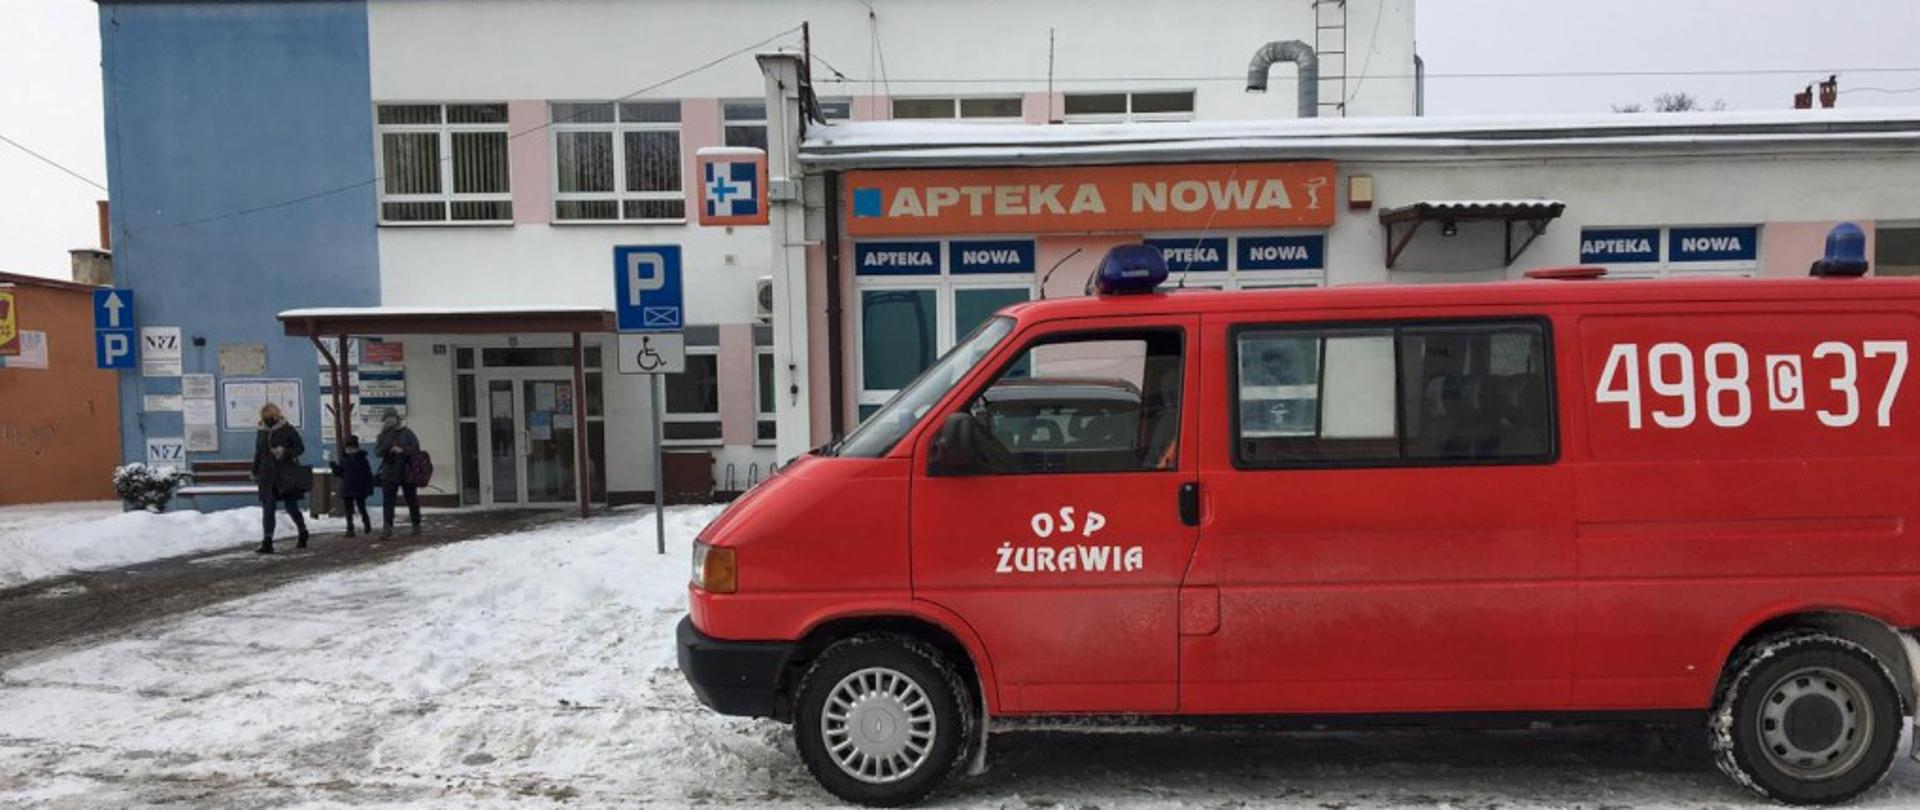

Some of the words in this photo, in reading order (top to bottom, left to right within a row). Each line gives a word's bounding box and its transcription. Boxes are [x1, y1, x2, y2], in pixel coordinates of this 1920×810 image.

[889, 183, 1107, 217] APTEKA
[1132, 179, 1292, 213] NOWA
[864, 251, 933, 267] APTEKA
[962, 249, 1020, 265] NOWA
[1163, 247, 1219, 262] PTEKA
[1250, 245, 1309, 261] NOWA
[1582, 239, 1652, 254] APTEKA
[1682, 236, 1741, 251] NOWA
[628, 253, 664, 305] P
[105, 334, 127, 365] P
[150, 444, 182, 459] NFZ
[1031, 506, 1106, 538] OSP
[995, 541, 1143, 573] ŻURAWIA
